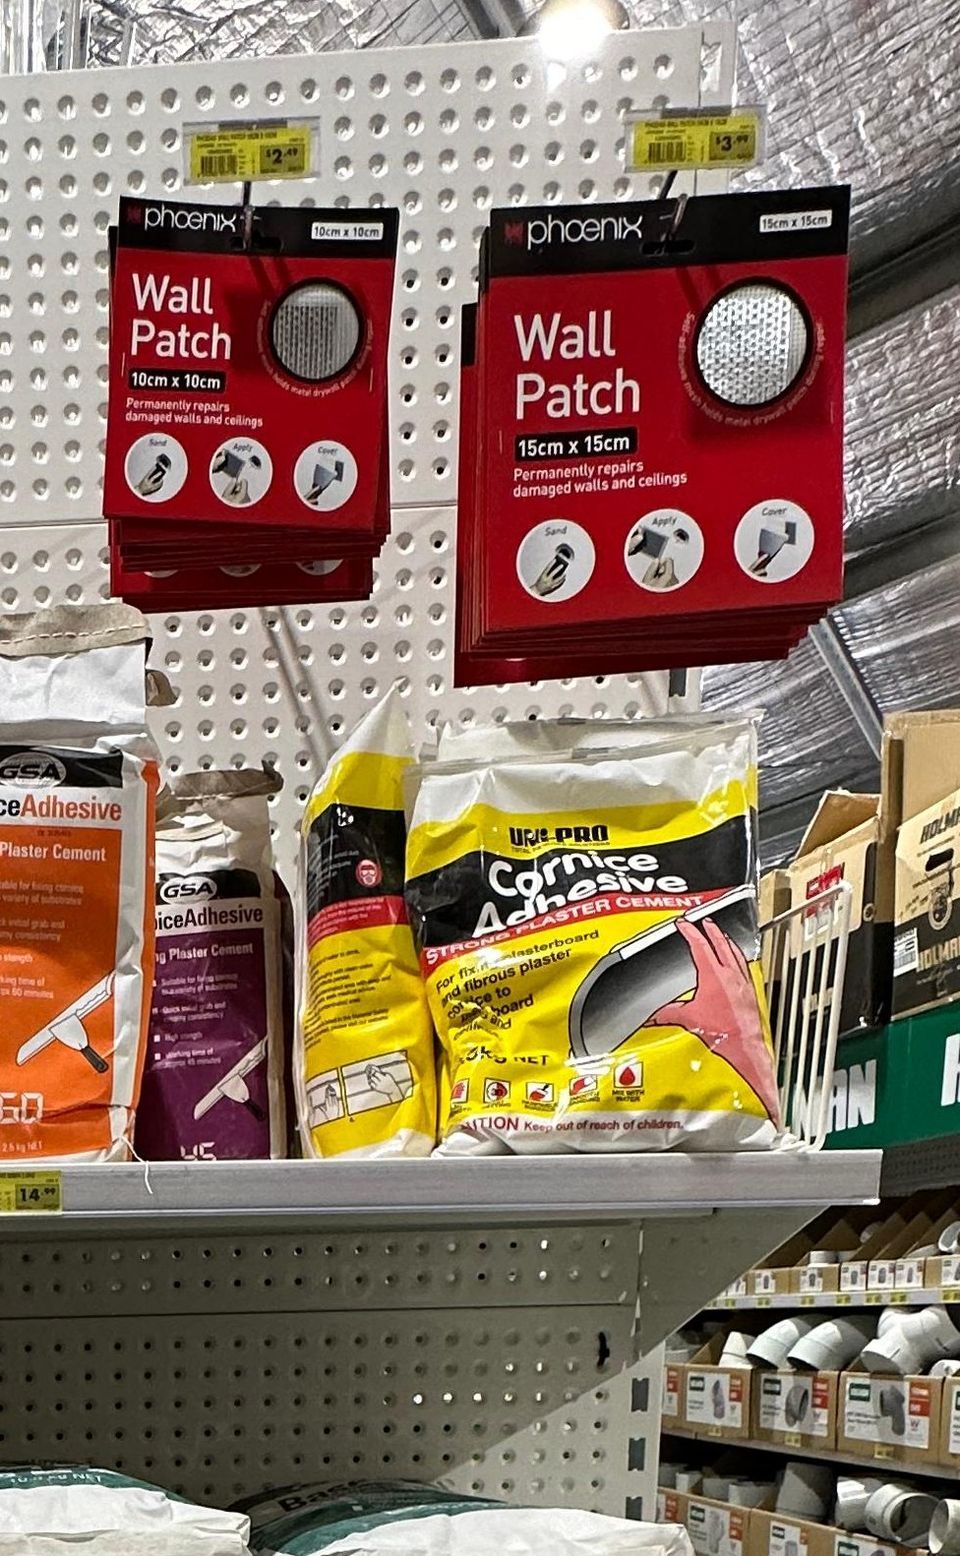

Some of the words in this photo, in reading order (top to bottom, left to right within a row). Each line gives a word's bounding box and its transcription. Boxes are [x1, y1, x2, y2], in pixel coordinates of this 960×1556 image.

[762, 217, 789, 230] 15cm
[801, 214, 828, 227] 15cm
[313, 225, 341, 239] 10cm
[353, 227, 381, 239] 10cm
[132, 273, 213, 316] Wall
[130, 318, 232, 361] Patch
[514, 310, 616, 362] Wall
[131, 371, 168, 390] 10cm
[171, 376, 179, 388] x
[184, 374, 220, 391] 10cm
[516, 368, 640, 420] Patch
[127, 398, 190, 415] Permanently
[193, 402, 230, 416] repairs
[126, 411, 172, 428] damaged
[174, 413, 201, 425] walls
[204, 414, 222, 426] and
[224, 414, 263, 430] ceilings
[233, 443, 254, 455] Apply
[317, 447, 338, 457] Cover
[518, 438, 564, 459] 15cm
[568, 439, 579, 456] x
[583, 434, 630, 454] 15cm
[513, 463, 596, 487] Permanently
[598, 459, 643, 480] repairs
[513, 483, 572, 501] damaged
[574, 479, 609, 494] walls
[612, 475, 637, 490] and
[639, 471, 688, 490] ceilings
[762, 506, 787, 517] Cover
[544, 525, 567, 537] Sand
[652, 516, 677, 528] Apply
[0, 764, 61, 780] GSA
[0, 841, 48, 860] Plaster
[53, 843, 106, 862] Cement
[488, 850, 660, 898] Cornice
[164, 882, 214, 898] GSA
[472, 869, 689, 939] Adhesive
[426, 933, 510, 965] STRONG
[615, 895, 705, 910] CEMENT
[169, 945, 208, 961] Plaster
[211, 943, 254, 958] Cement
[463, 968, 516, 994] fibrous
[520, 949, 571, 977] plaster
[496, 986, 511, 1000] to
[524, 1121, 554, 1134] Keep
[557, 1121, 574, 1131] out
[576, 1119, 588, 1130] of
[589, 1119, 622, 1131] reach
[623, 1119, 635, 1130] of
[637, 1118, 684, 1131] children.
